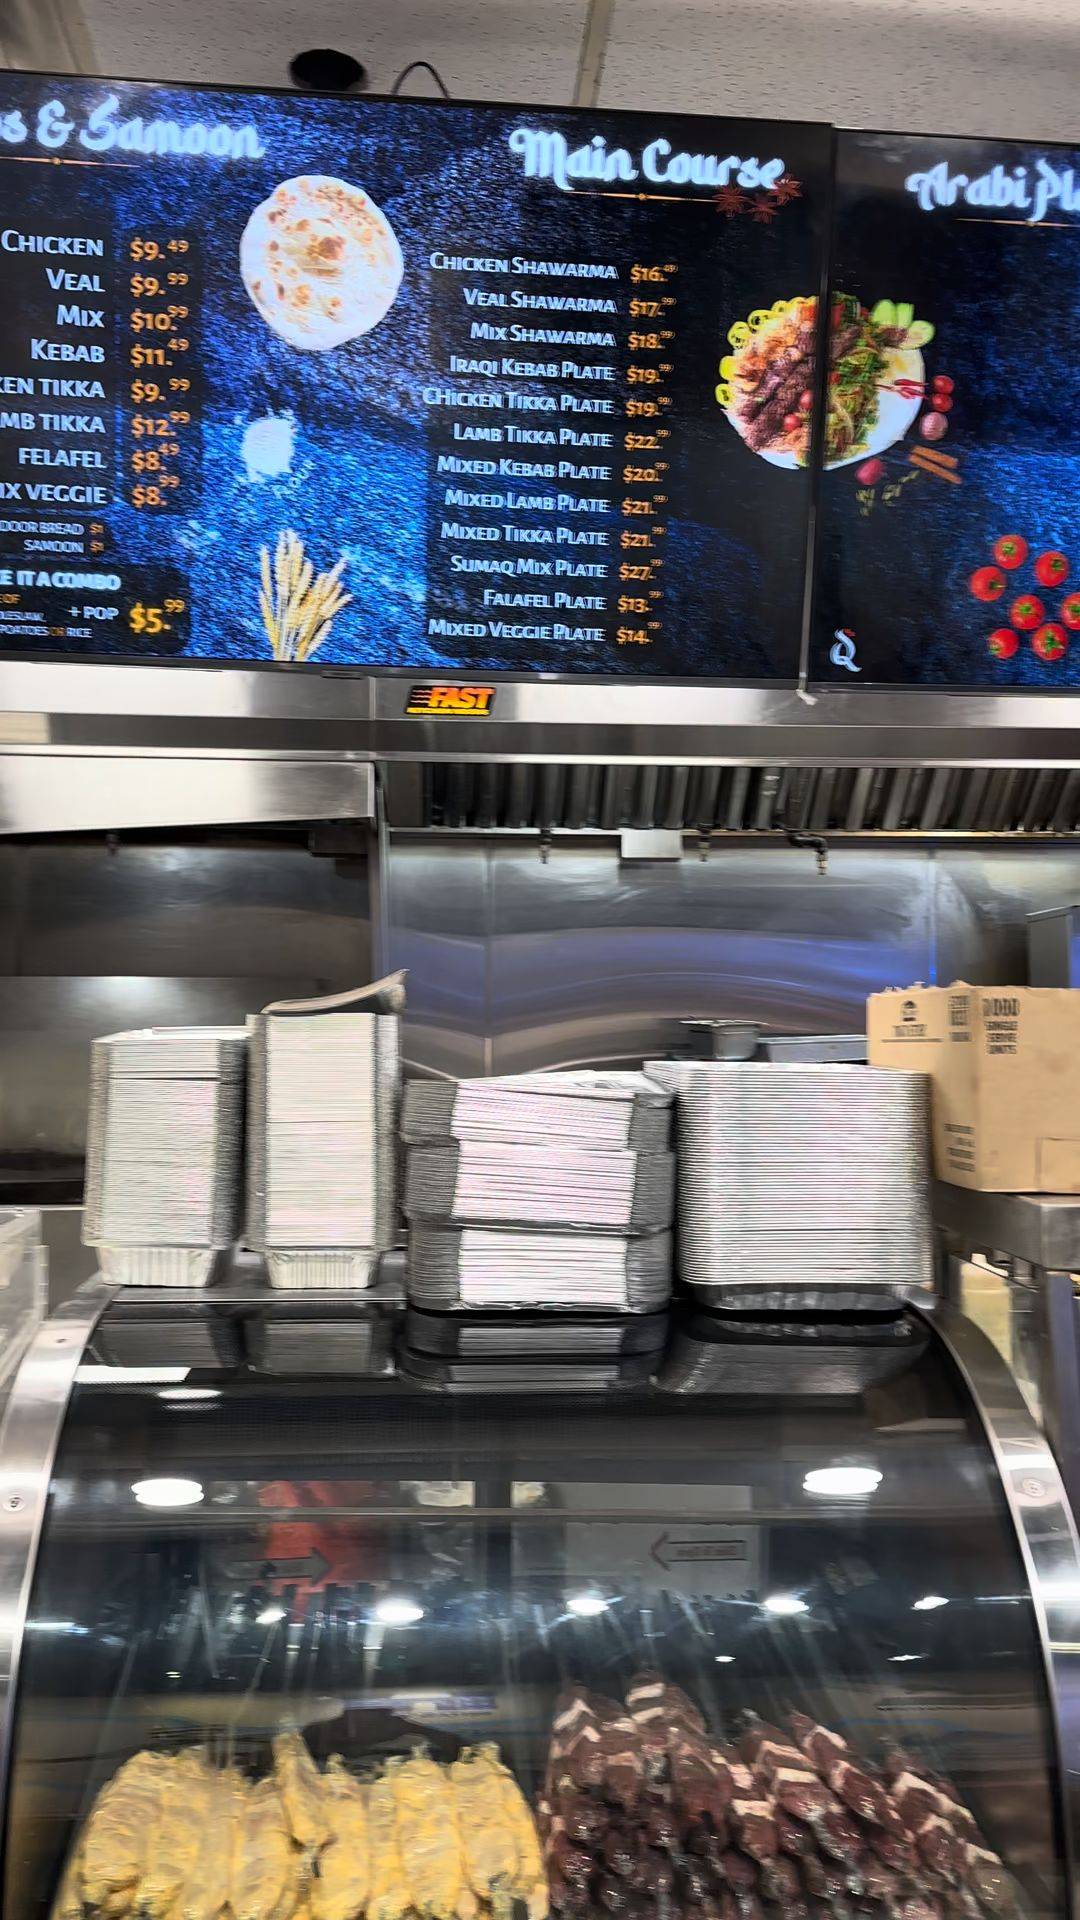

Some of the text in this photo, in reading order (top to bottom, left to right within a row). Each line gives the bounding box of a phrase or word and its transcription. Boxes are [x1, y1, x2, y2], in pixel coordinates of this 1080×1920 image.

[37, 99, 74, 148] &
[509, 128, 784, 190] Main Course
[905, 161, 1032, 210] Arabi
[1, 229, 104, 256] CHICKEN
[430, 252, 510, 272] CHICKEN
[511, 257, 619, 279] SHAWARMA
[45, 268, 106, 292] VEAL
[463, 288, 510, 307] VEAL
[510, 290, 618, 313] SHAWARMA
[57, 304, 105, 328] MIX
[471, 322, 508, 341] MIX
[509, 324, 617, 346] SHAWARMA
[31, 338, 105, 363] KEBAB
[450, 356, 498, 377] IRAQI
[501, 357, 560, 377] KEBAB
[562, 361, 616, 381] PLATE
[38, 378, 106, 398] TIKKA
[422, 387, 502, 408] CHICKEN
[504, 391, 559, 411] TIKKA
[561, 394, 615, 414] PLATE
[38, 413, 106, 433] TIKKA
[454, 423, 503, 441] LAMB
[504, 425, 559, 445] TIKKA
[560, 428, 614, 448] PLATE
[18, 447, 107, 468] FELAFEL
[437, 455, 498, 475] MIXED
[499, 458, 557, 478] KEBAB
[558, 461, 612, 480] PLATE
[24, 483, 108, 504] VEGGIE
[444, 489, 506, 508] MIXED
[506, 492, 556, 510] LAMB
[557, 494, 611, 513] PLATE
[441, 521, 501, 542] MIXED
[502, 525, 556, 545] TIKKA
[556, 527, 610, 546] PLATE
[450, 555, 517, 577] SUMAQ
[517, 558, 555, 576] MIX
[555, 559, 609, 578] PLATE
[483, 589, 553, 608] FALAFEL
[554, 592, 607, 610] PLATE
[428, 618, 488, 637] MIXED
[488, 621, 553, 640] VEGGIE
[553, 624, 606, 642] PLATE
[428, 687, 495, 709] FAST
